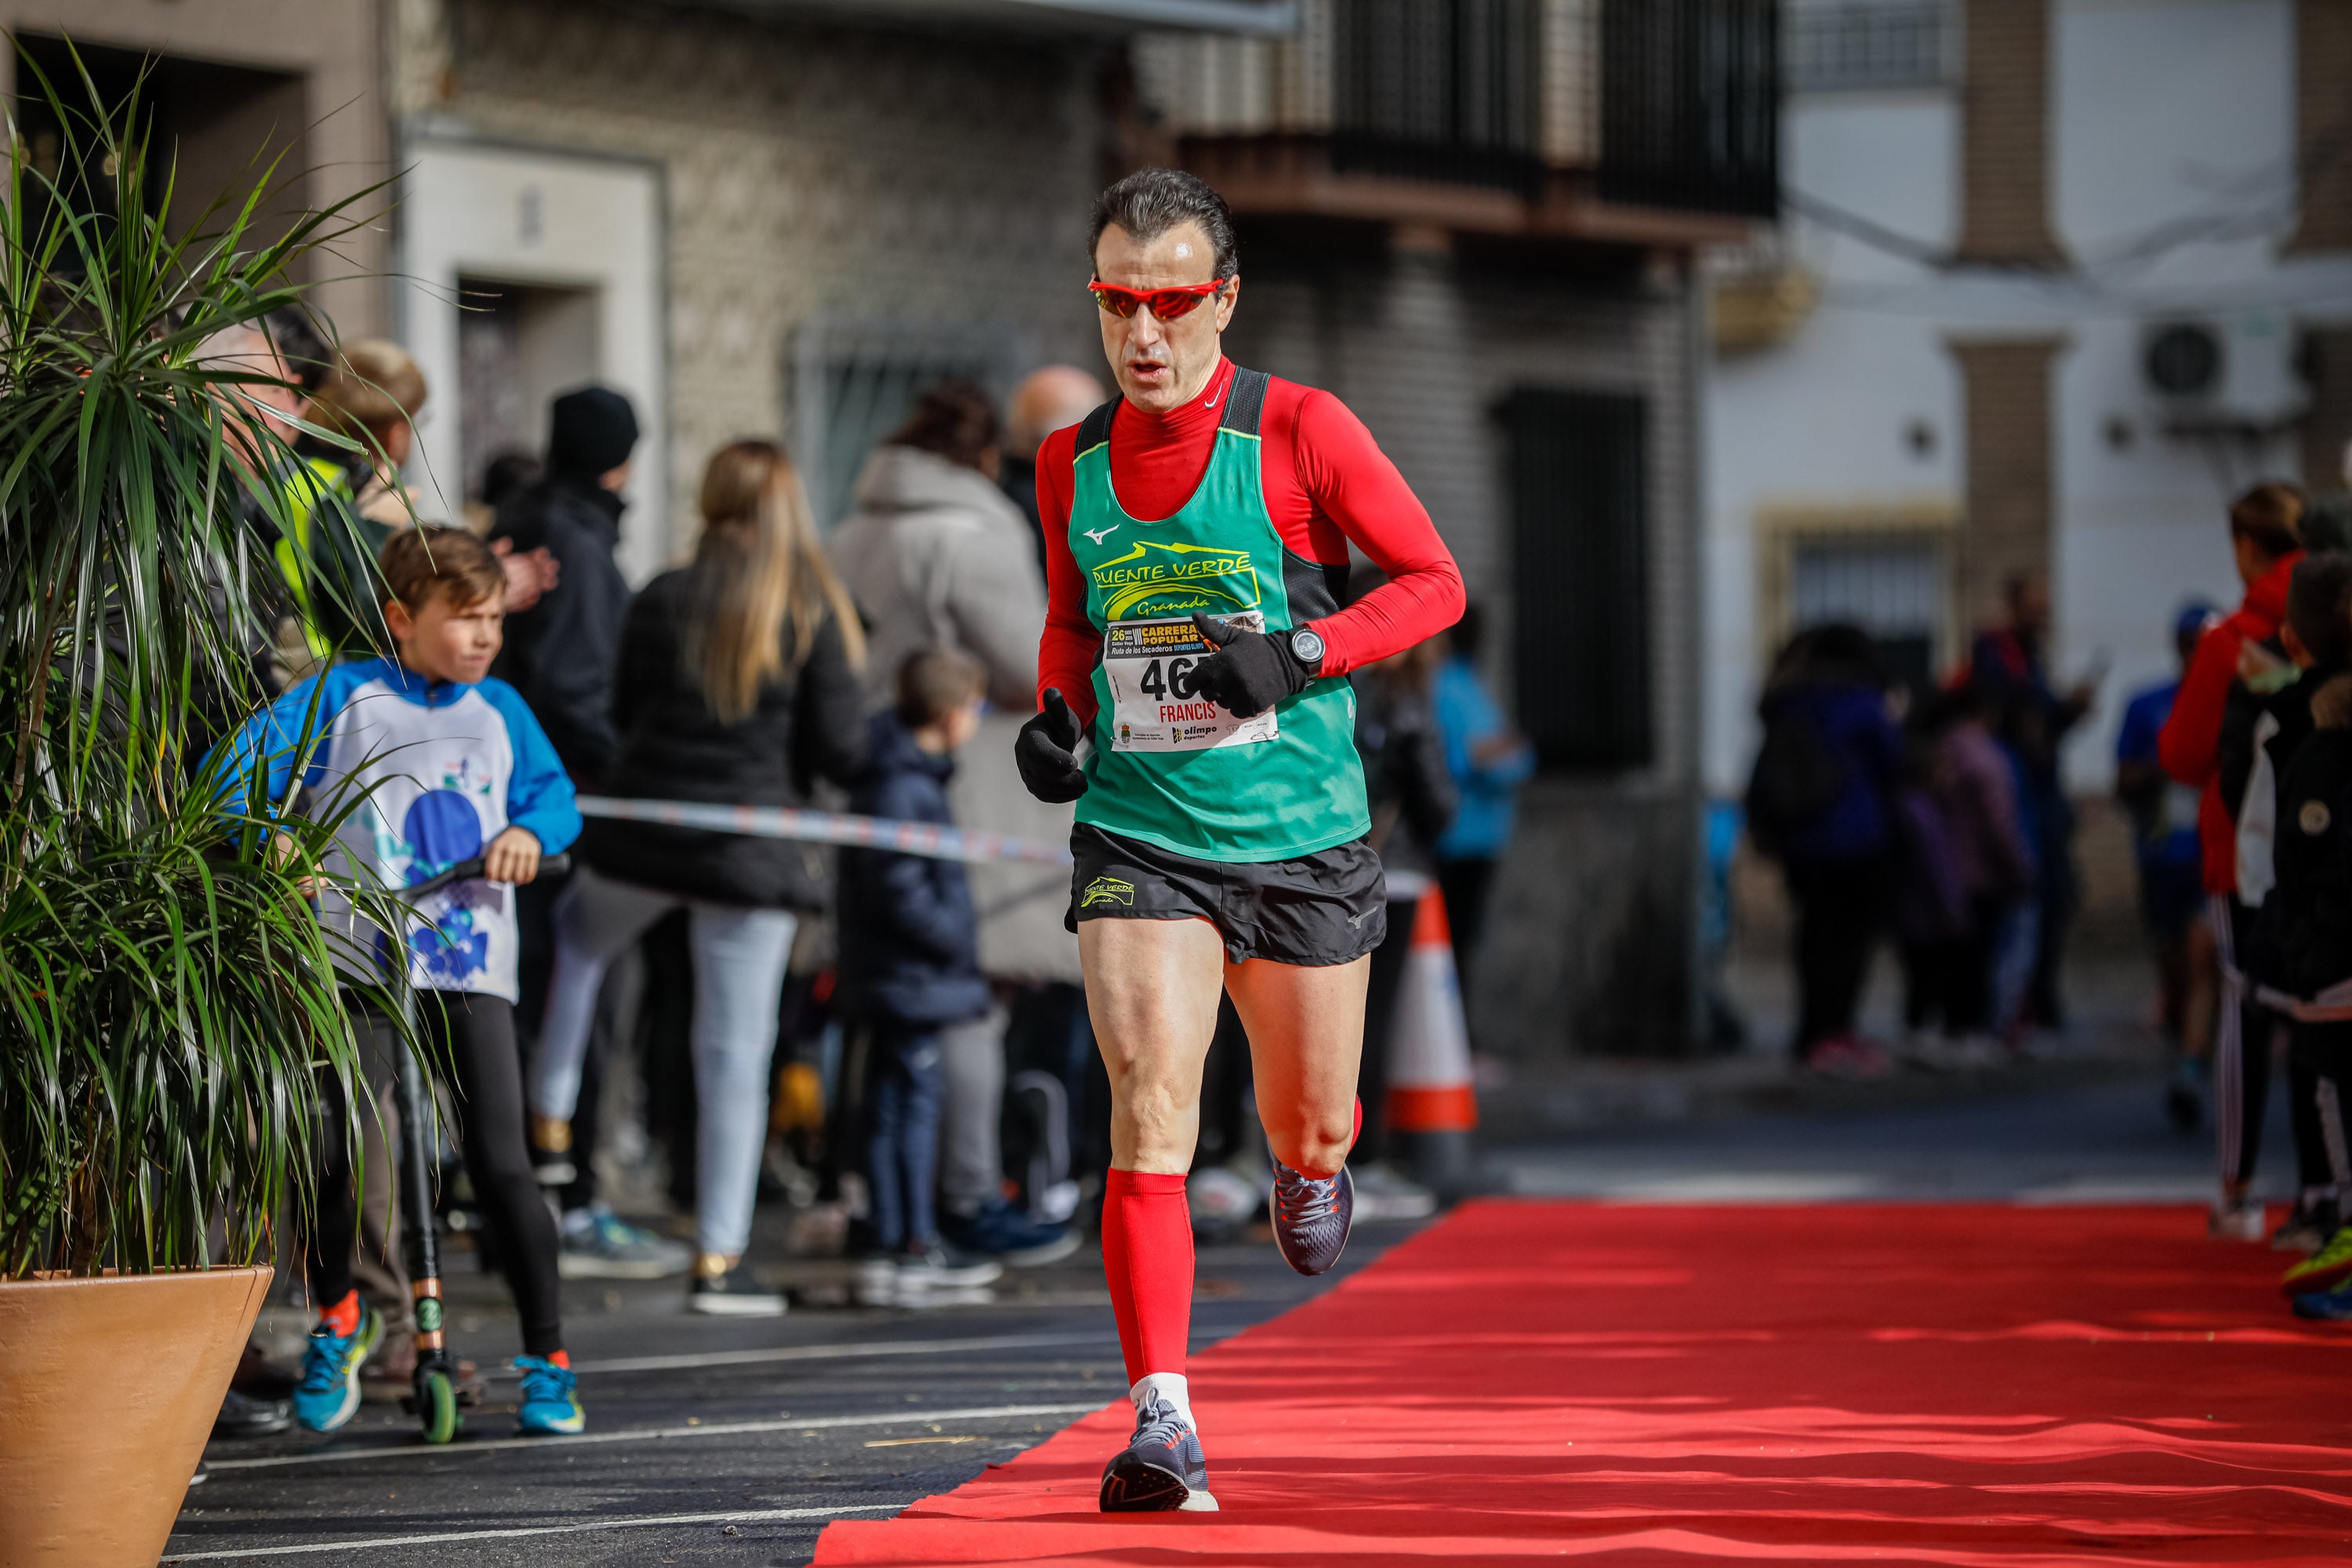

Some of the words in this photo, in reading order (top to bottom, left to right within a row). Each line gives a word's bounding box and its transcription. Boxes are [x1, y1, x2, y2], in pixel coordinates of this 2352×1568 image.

[1093, 565, 1165, 584] PUENTE
[1173, 554, 1251, 577] VERDE
[1138, 596, 1210, 615] Granada
[1112, 630, 1125, 641] 26
[1142, 625, 1198, 637] CARRERA
[1143, 634, 1199, 645] POPULAR
[1111, 647, 1124, 655] Ruta
[1125, 646, 1133, 655] de
[1142, 645, 1173, 654] Secaderos
[1140, 658, 1208, 701] 46
[1160, 702, 1217, 723] FRANCIS
[1184, 726, 1217, 735] olimpo
